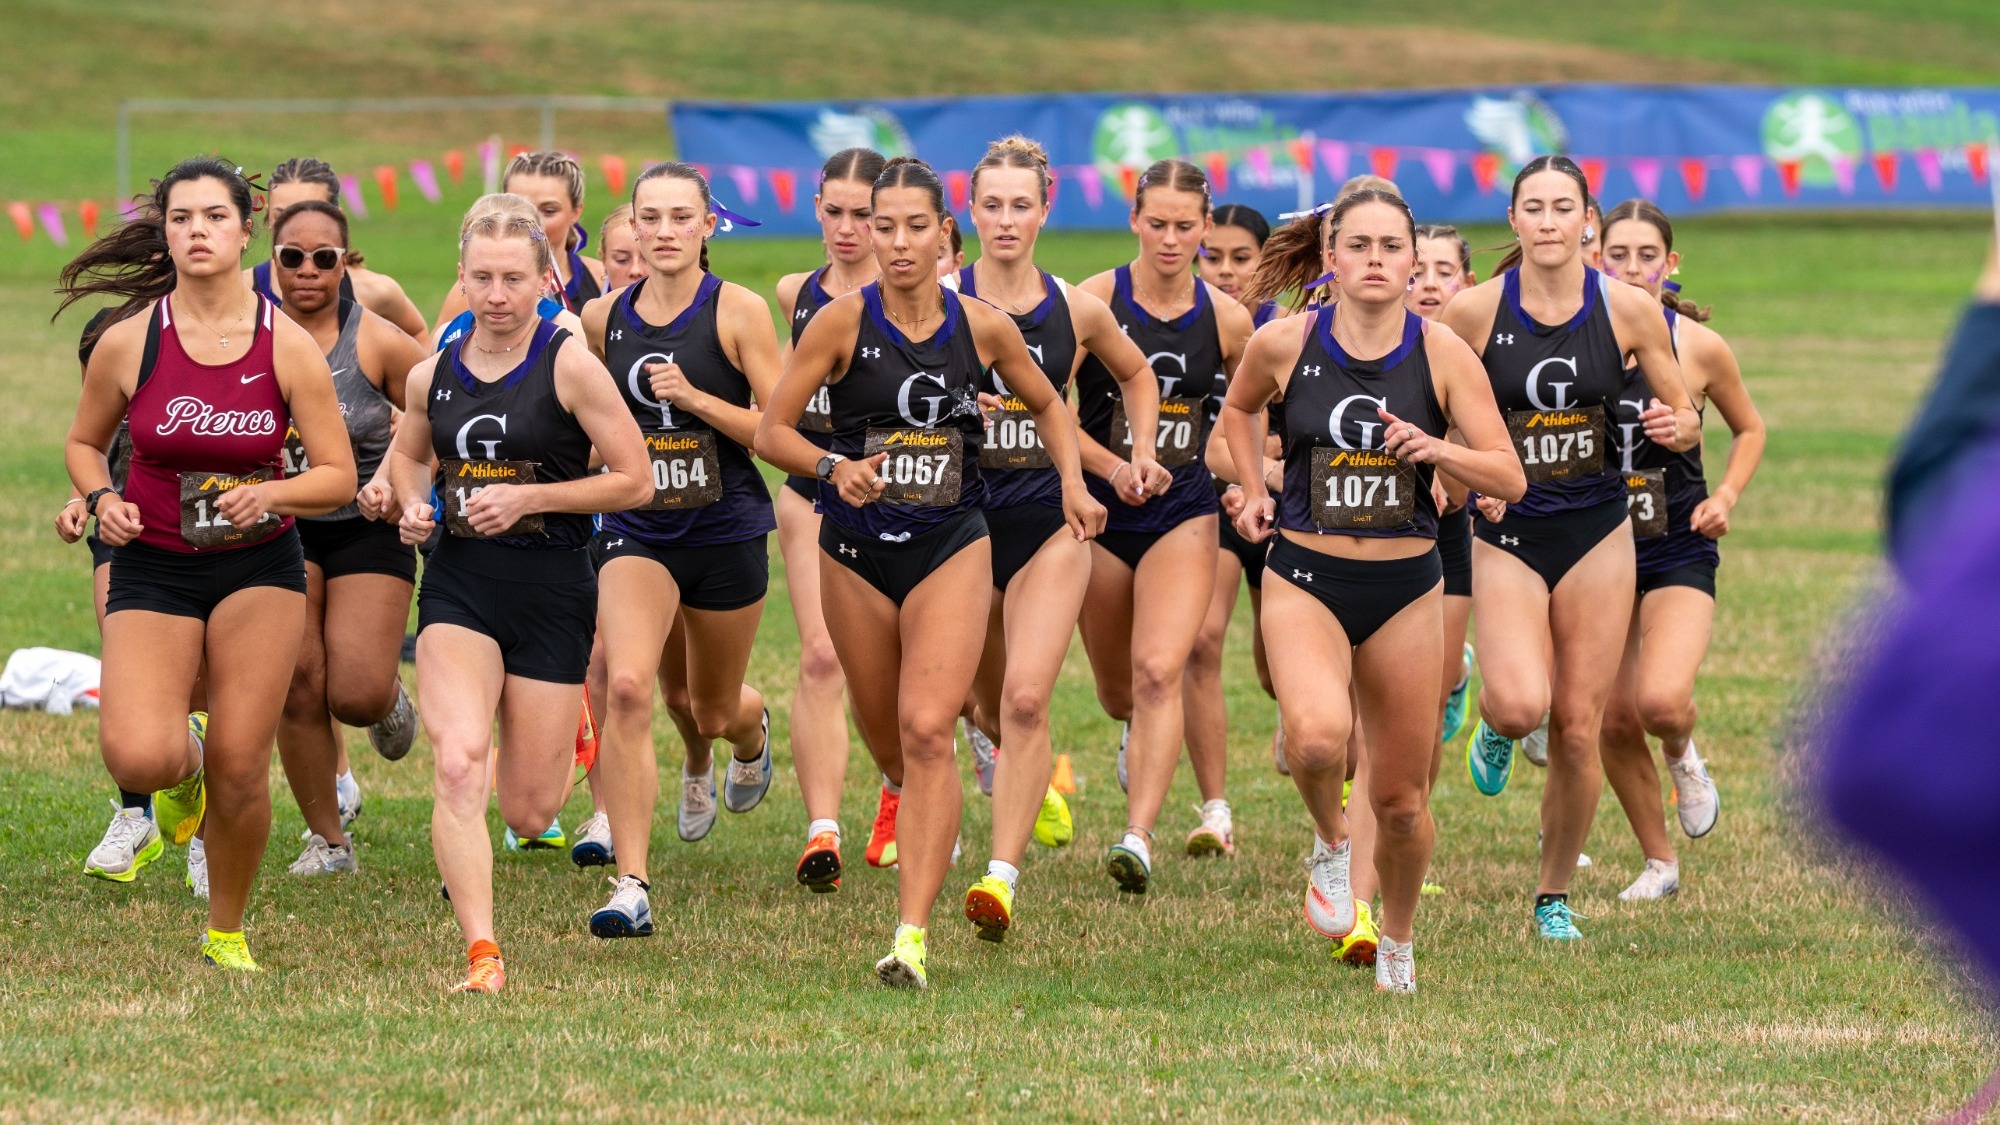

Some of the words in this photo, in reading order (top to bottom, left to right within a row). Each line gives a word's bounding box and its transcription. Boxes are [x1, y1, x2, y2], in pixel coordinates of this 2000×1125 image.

[1526, 356, 1578, 411] G
[897, 371, 951, 429] G
[1158, 400, 1190, 414] letic
[156, 396, 276, 436] Pierce
[1329, 394, 1387, 451] G
[1526, 412, 1589, 428] Athletic
[456, 413, 507, 460] G
[644, 436, 699, 450] Athletic
[883, 431, 948, 446] Athletic
[1123, 420, 1192, 449] 170
[1523, 430, 1594, 465] 1075
[458, 463, 516, 478] Athletic
[652, 457, 708, 490] 064
[881, 454, 950, 485] 1067
[1329, 451, 1397, 467] Athletic
[1325, 475, 1400, 507] 1071
